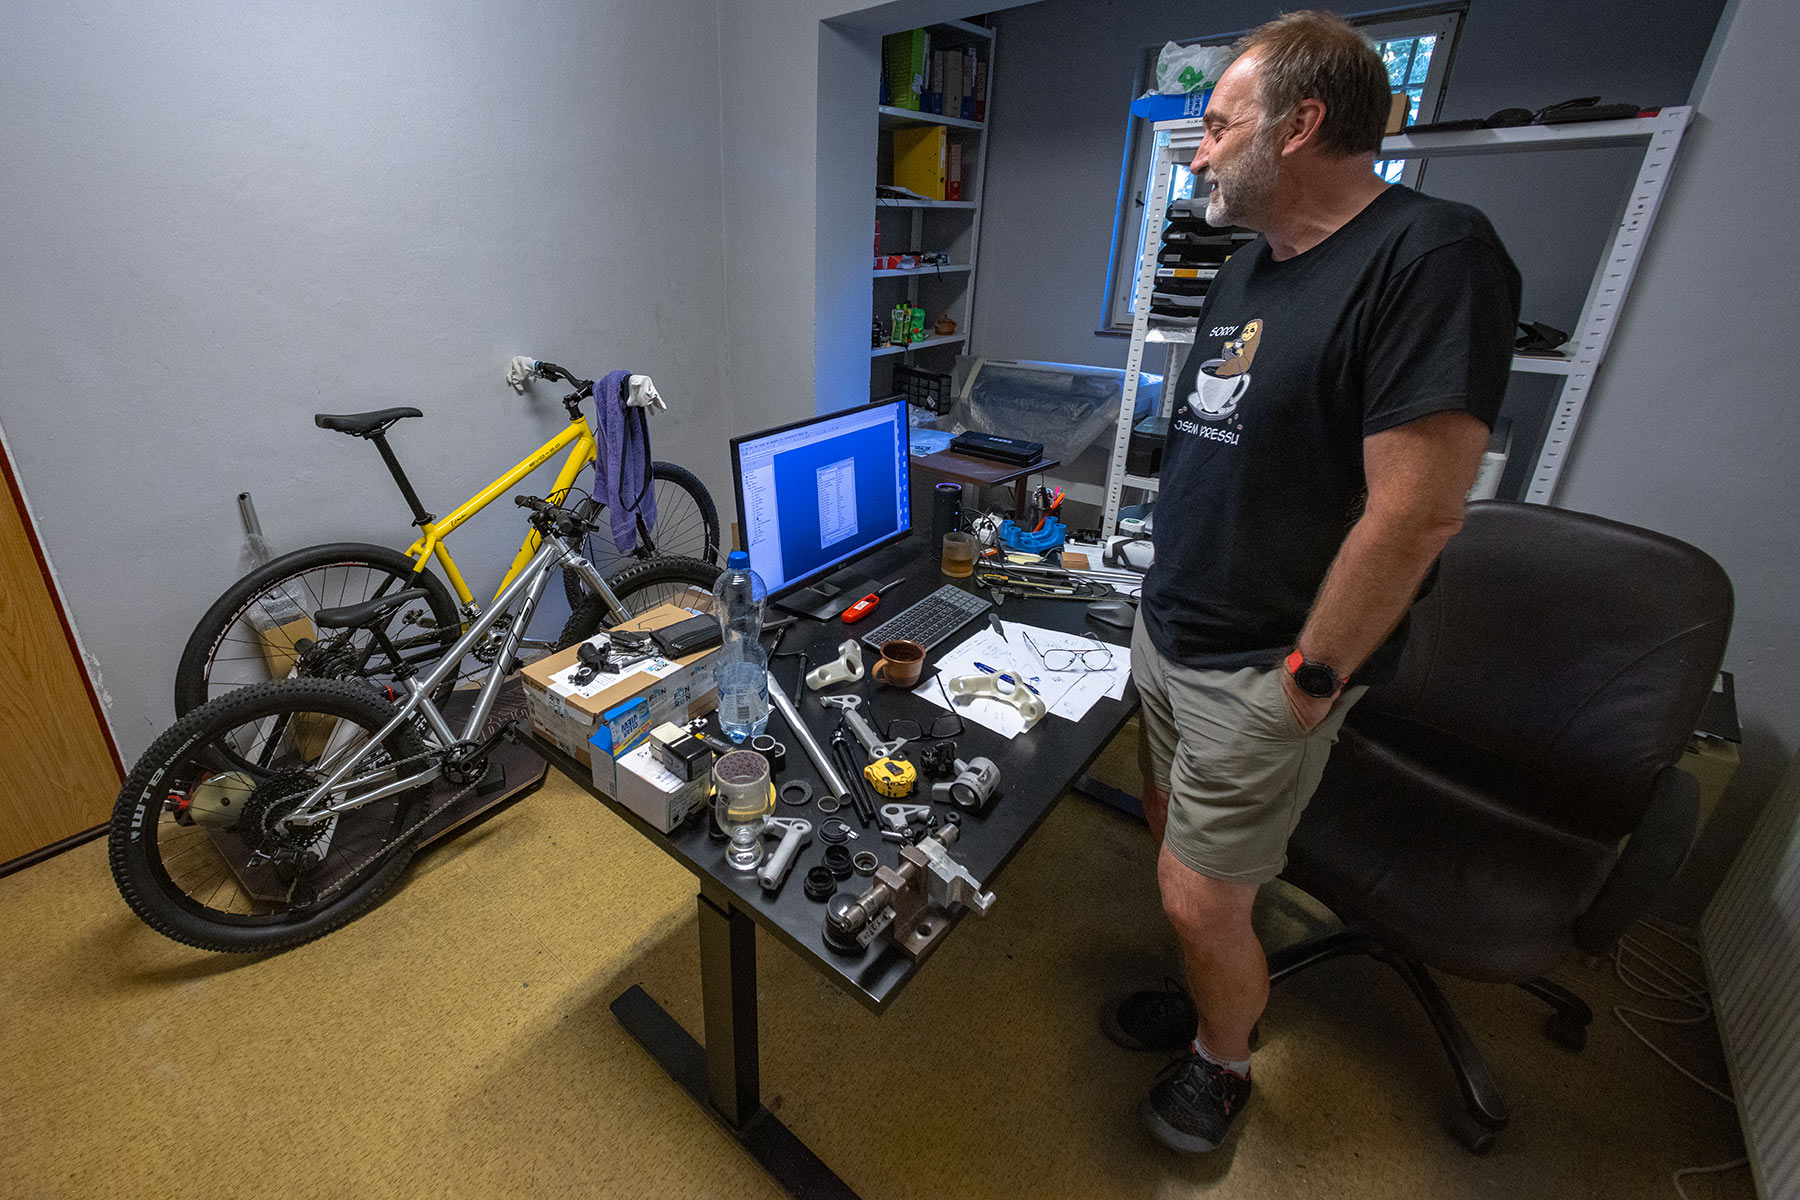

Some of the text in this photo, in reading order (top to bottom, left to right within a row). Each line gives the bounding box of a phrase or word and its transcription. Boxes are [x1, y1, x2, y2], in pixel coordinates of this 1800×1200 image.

[1209, 325, 1240, 337] SORRY
[1174, 419, 1240, 446] JSEM PRESSU
[621, 714, 638, 732] VIEW
[623, 721, 639, 738] CLEAR
[130, 739, 196, 829] WTB RANGER
